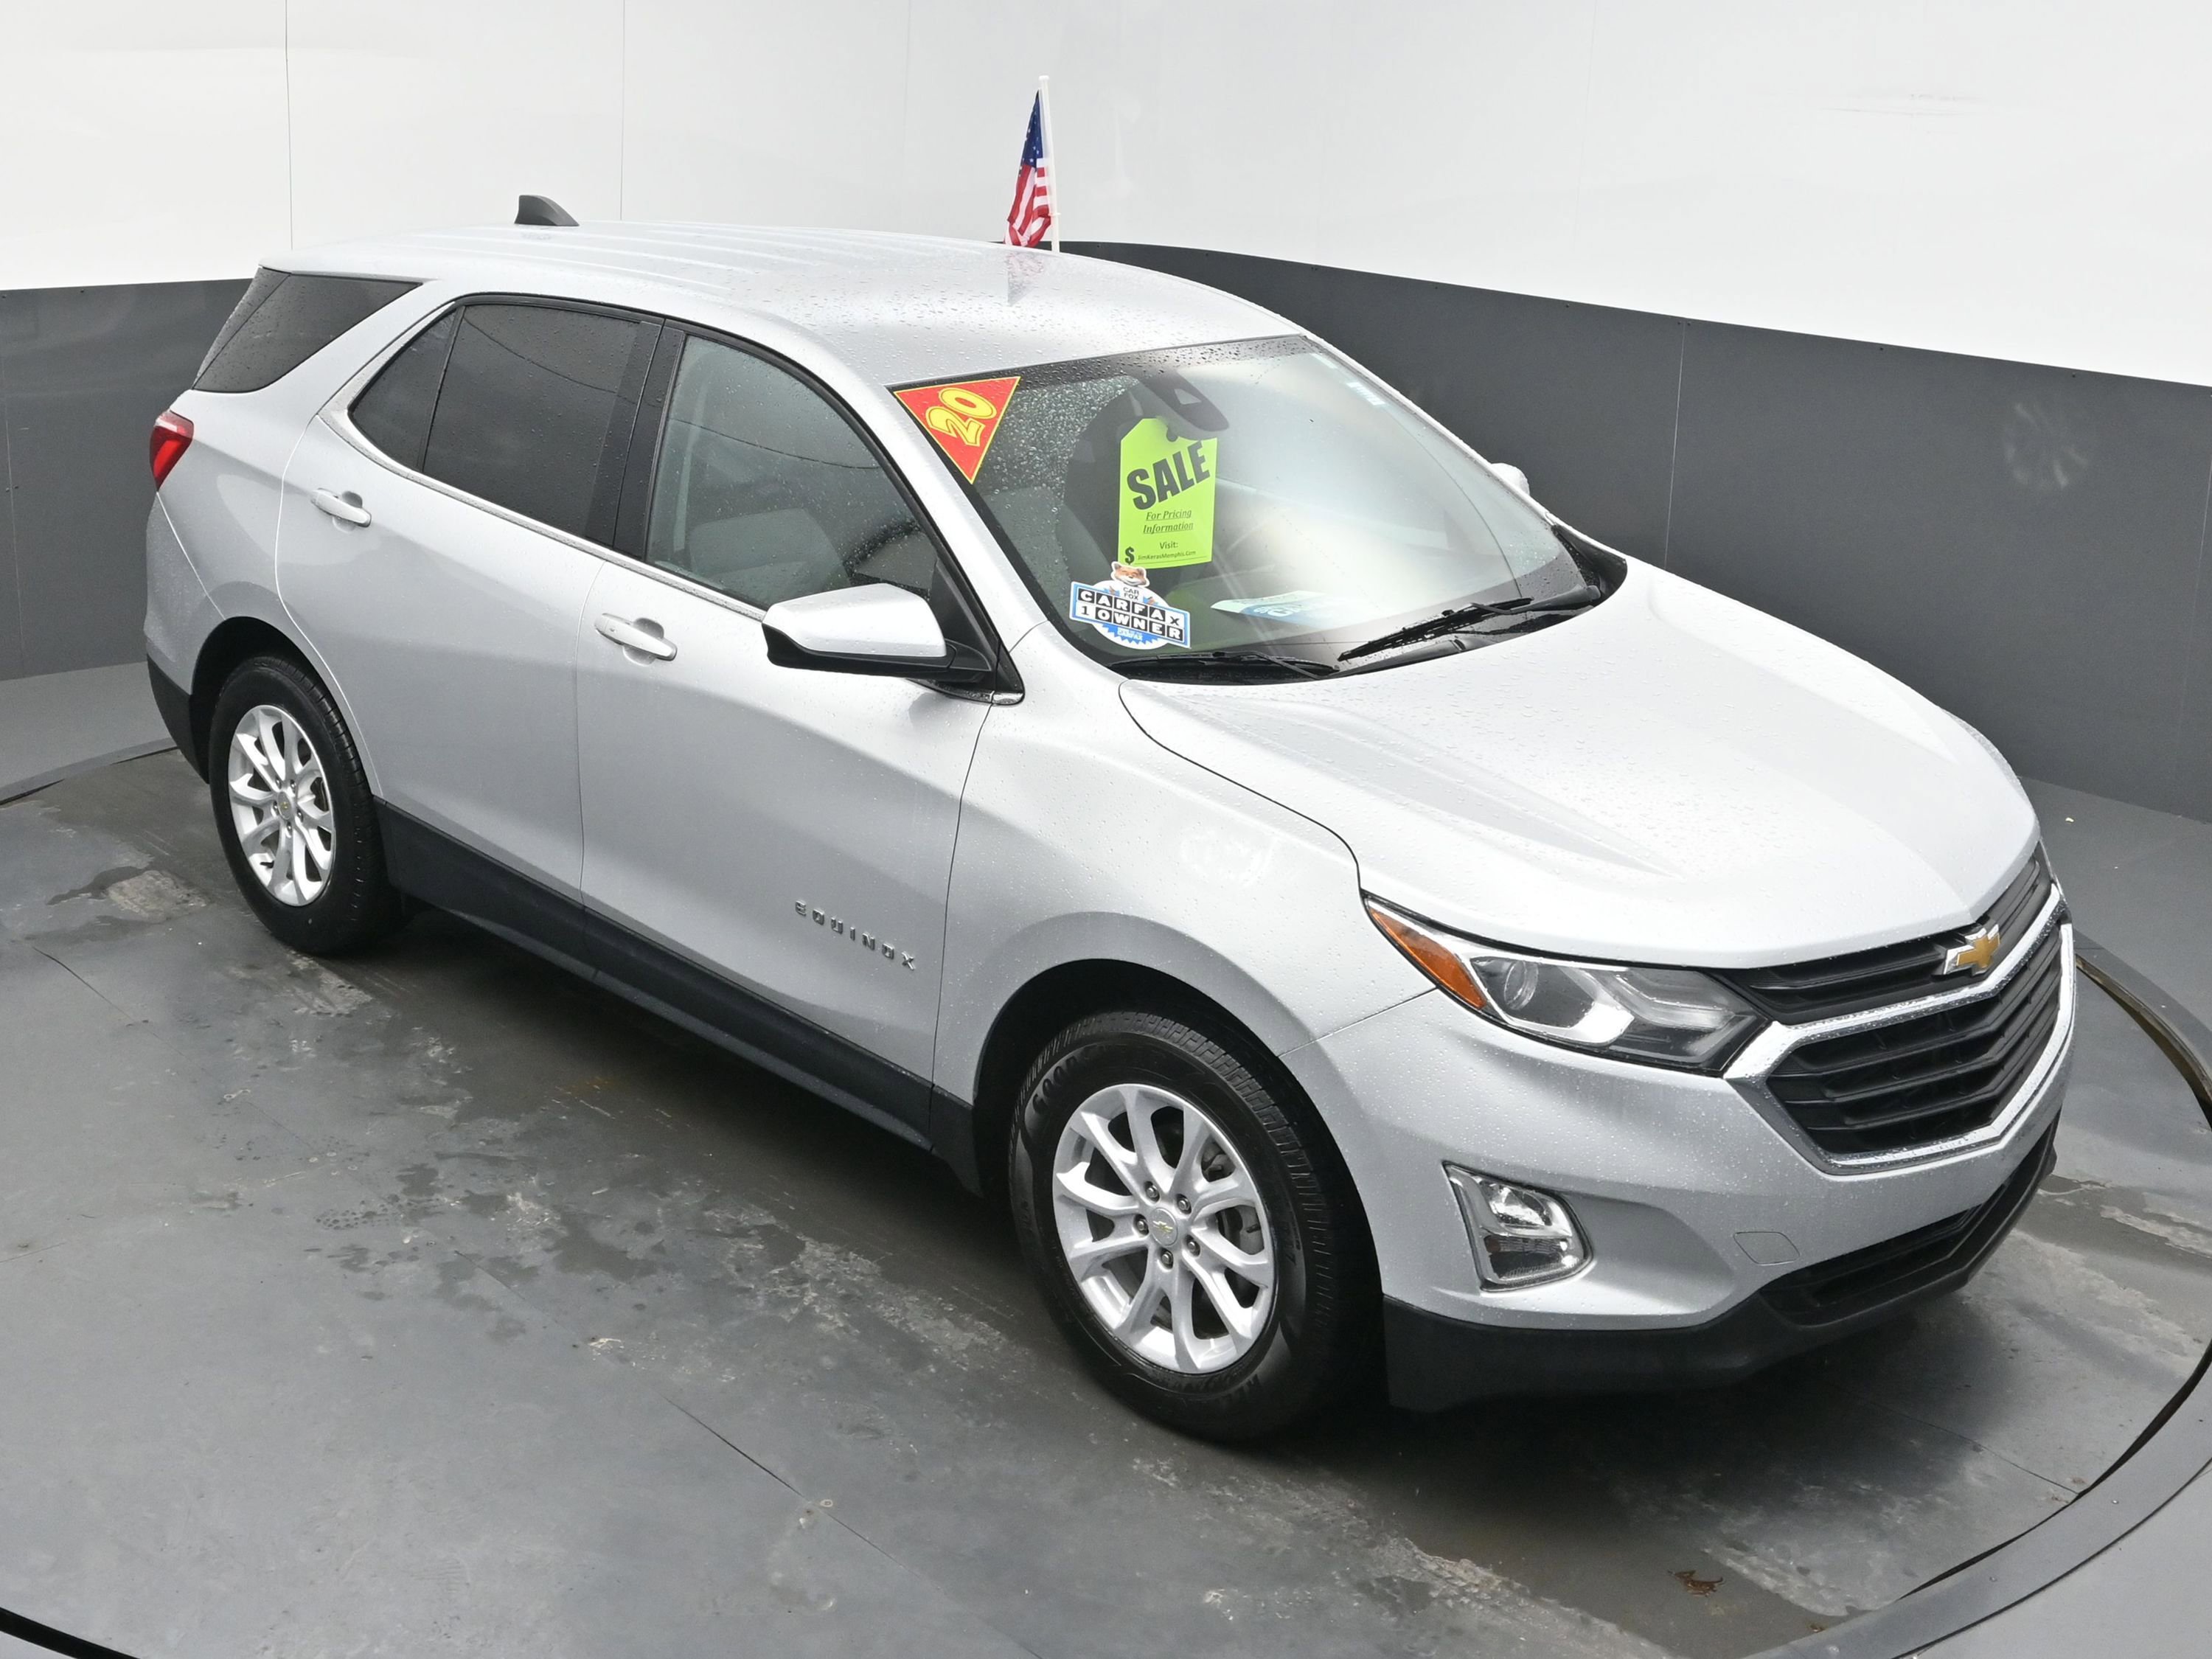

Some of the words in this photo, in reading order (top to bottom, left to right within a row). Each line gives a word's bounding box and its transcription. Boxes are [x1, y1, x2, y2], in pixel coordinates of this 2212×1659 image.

[925, 387, 998, 447] 20
[1127, 440, 1211, 510] SALE
[1146, 511, 1161, 521] For
[1163, 509, 1192, 520] Pricing
[1143, 521, 1194, 535] Information
[1159, 541, 1179, 549] Visit:
[1124, 546, 1135, 566] $
[1123, 587, 1140, 595] CAR
[1124, 593, 1139, 601] FOX
[1079, 589, 1180, 627] CARFAX
[1081, 605, 1090, 616] 1
[1096, 608, 1181, 640] OWNER
[795, 900, 916, 971] EQUINOX
